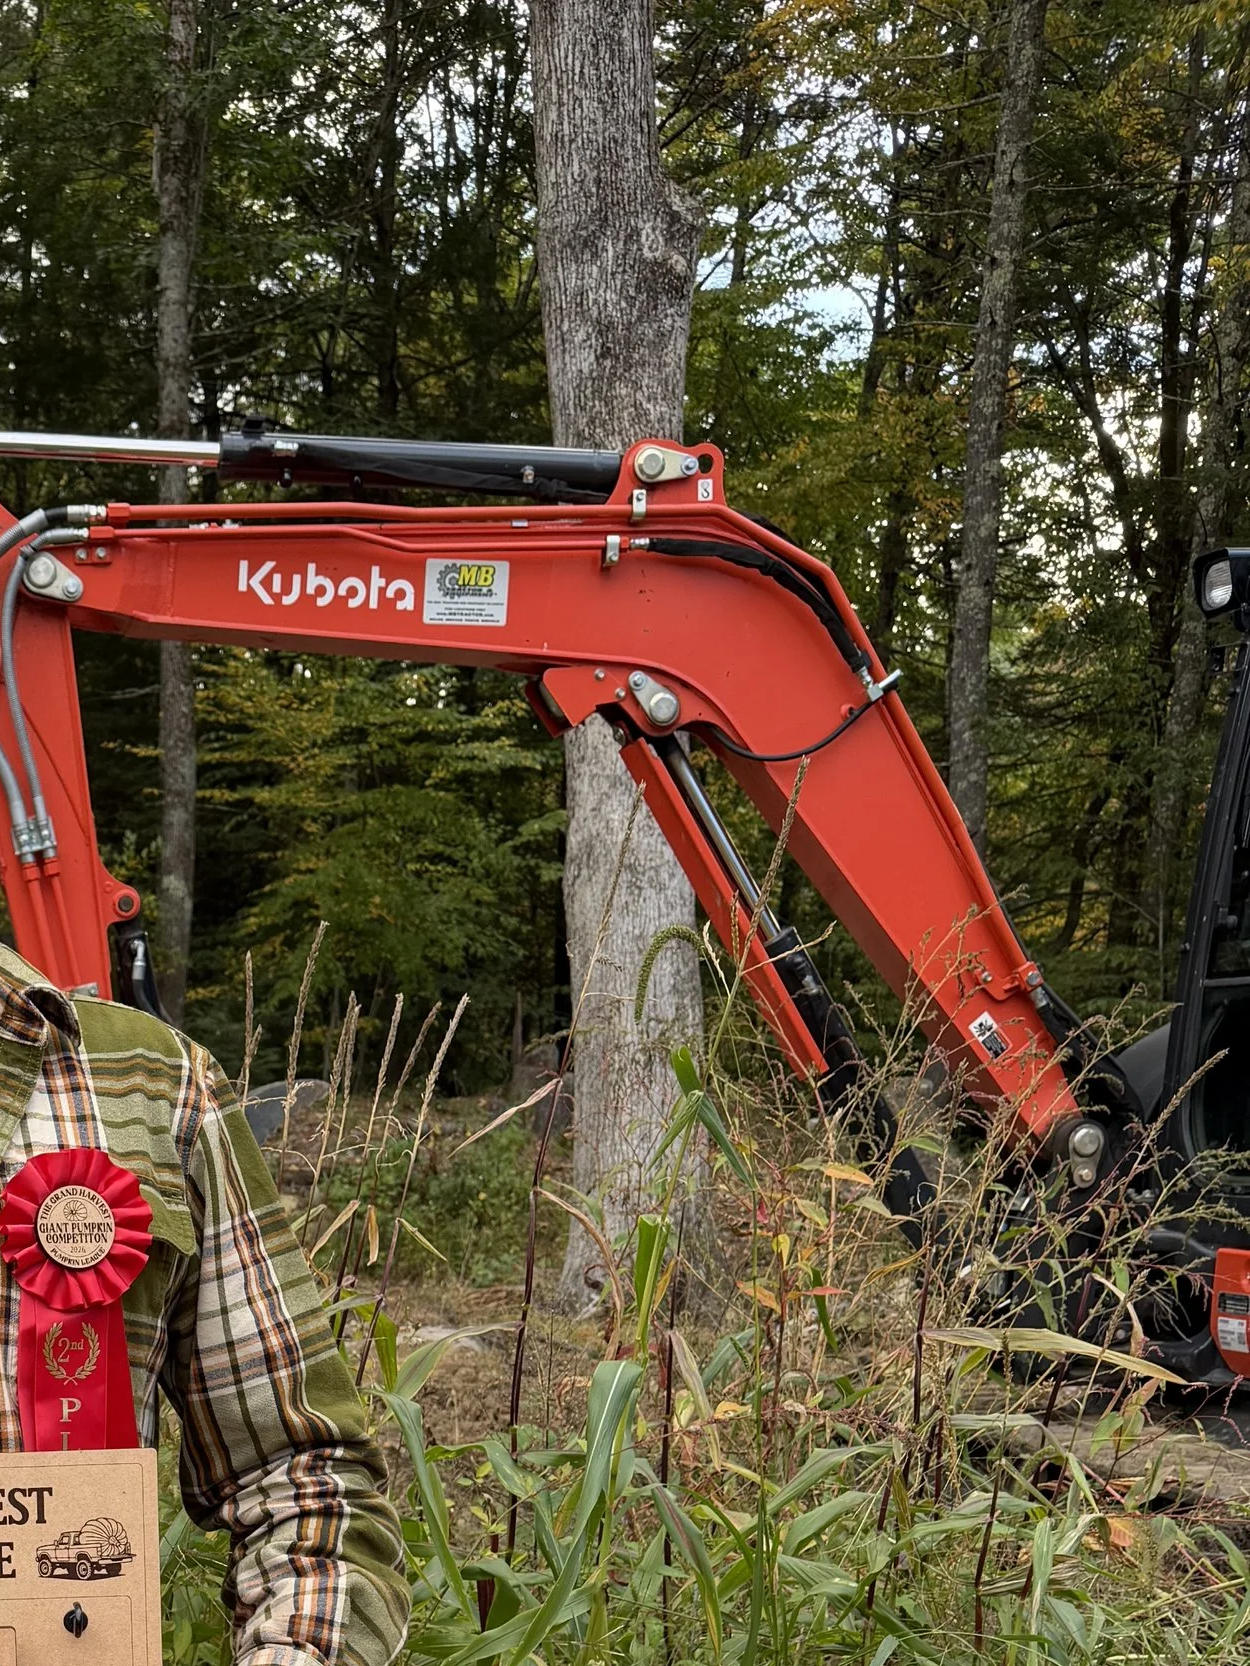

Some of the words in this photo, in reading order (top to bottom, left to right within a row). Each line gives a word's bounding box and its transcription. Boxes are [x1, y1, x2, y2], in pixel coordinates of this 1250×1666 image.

[238, 560, 415, 611] Kubota
[456, 564, 496, 587] MB
[40, 1202, 52, 1220] THE
[50, 1187, 78, 1204] GRAND
[79, 1188, 111, 1219] HARVEST
[39, 1222, 69, 1233] GIANT
[71, 1222, 113, 1233] PUMPKIN
[50, 1247, 80, 1266] PUMPKIN
[80, 1246, 105, 1266] LEAGUE
[57, 1337, 84, 1363] 2nd
